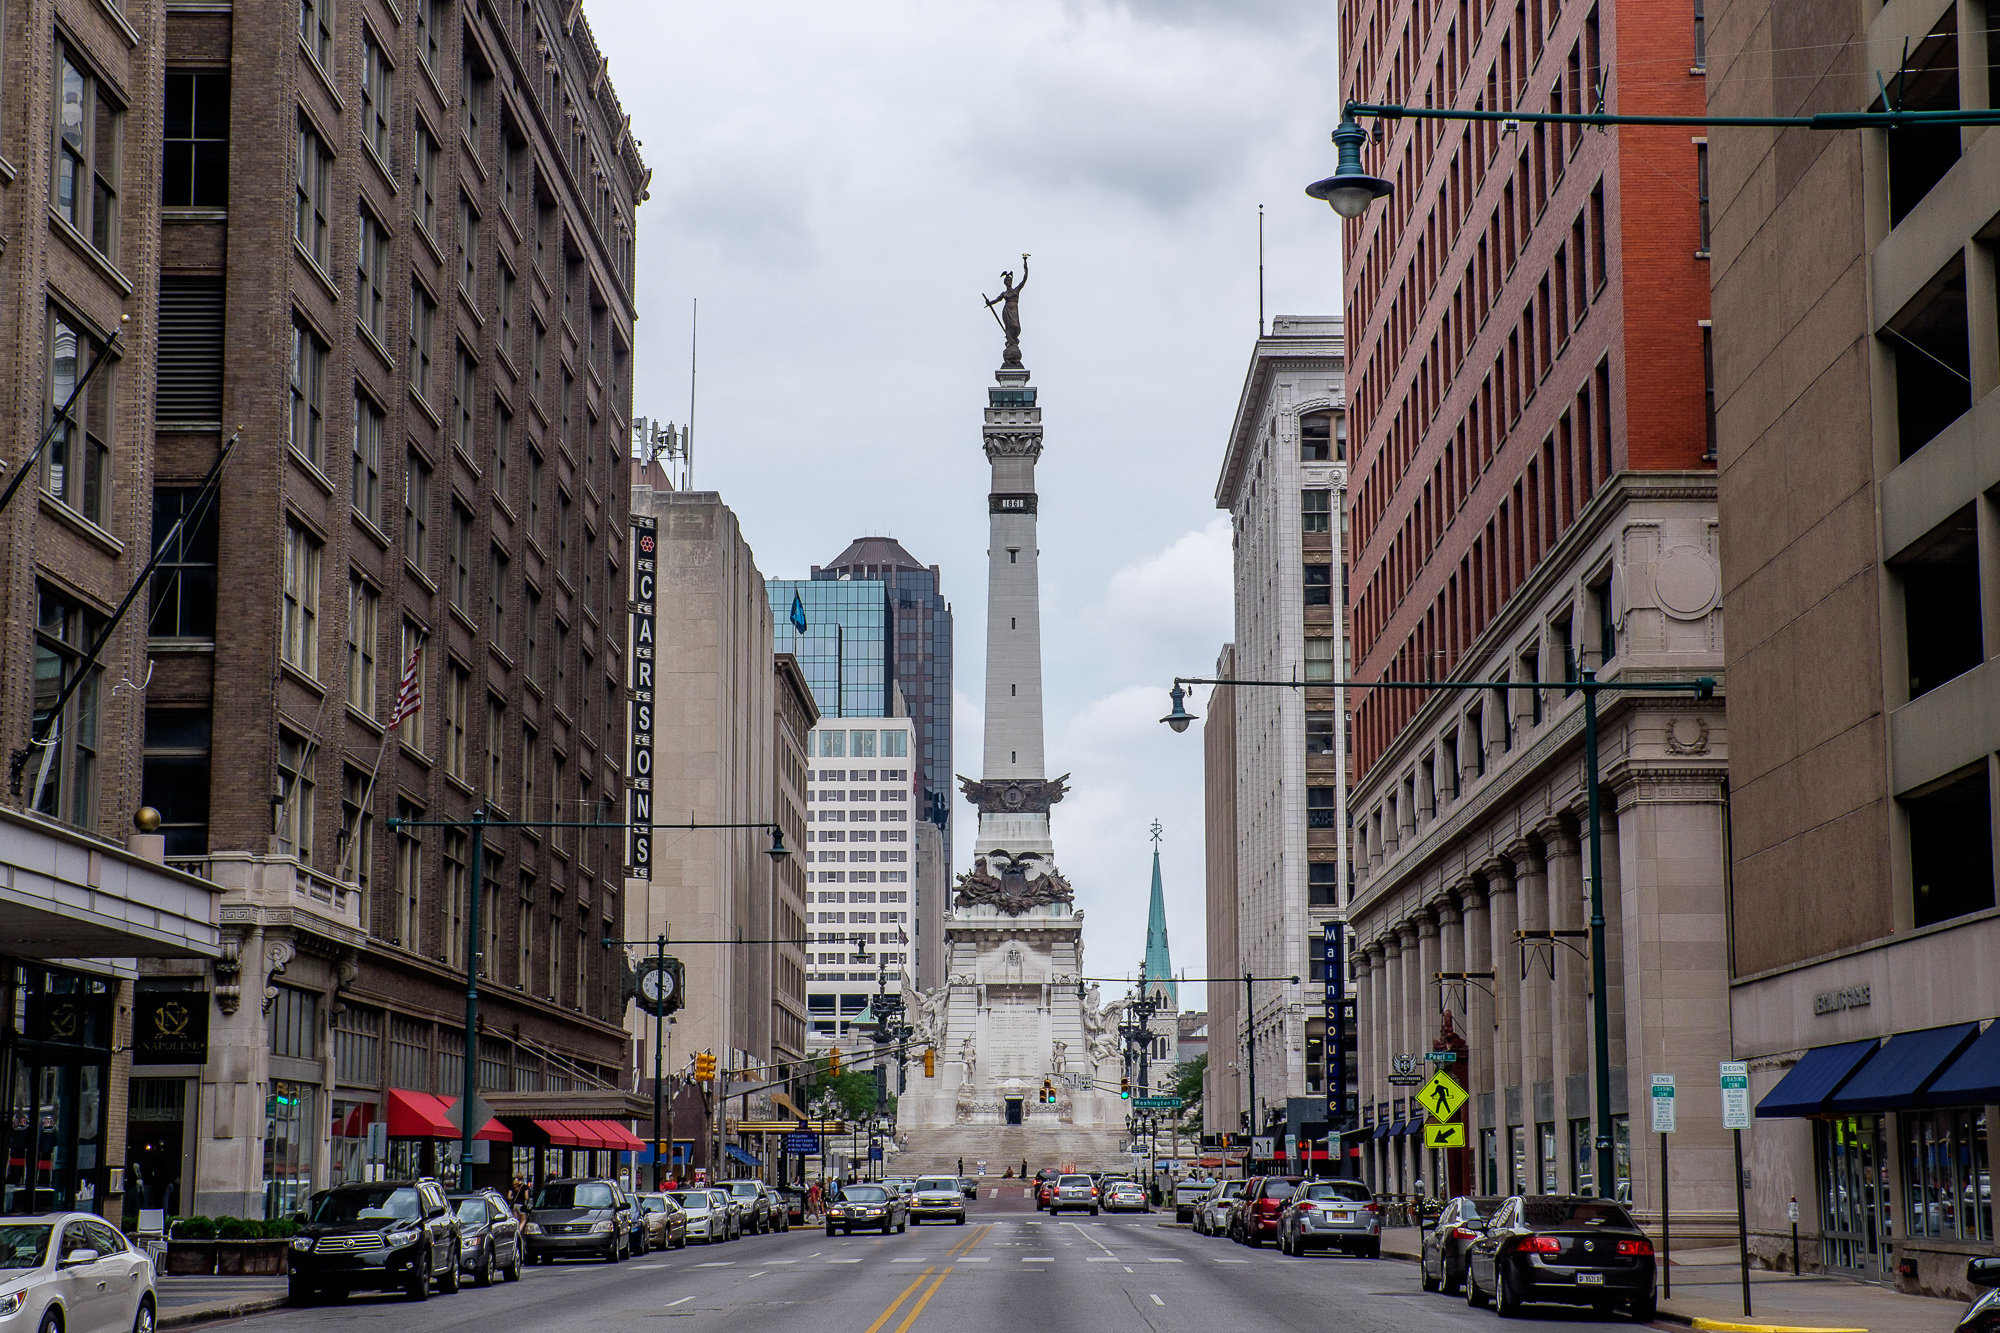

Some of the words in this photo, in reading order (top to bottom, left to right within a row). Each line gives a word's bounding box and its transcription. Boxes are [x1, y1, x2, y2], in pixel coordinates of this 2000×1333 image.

[637, 575, 653, 863] CARSONS
[1325, 929, 1336, 995] Main
[143, 1041, 200, 1050] NAPOLESE
[1328, 1006, 1337, 1111] Source
[1135, 1099, 1171, 1107] Washington
